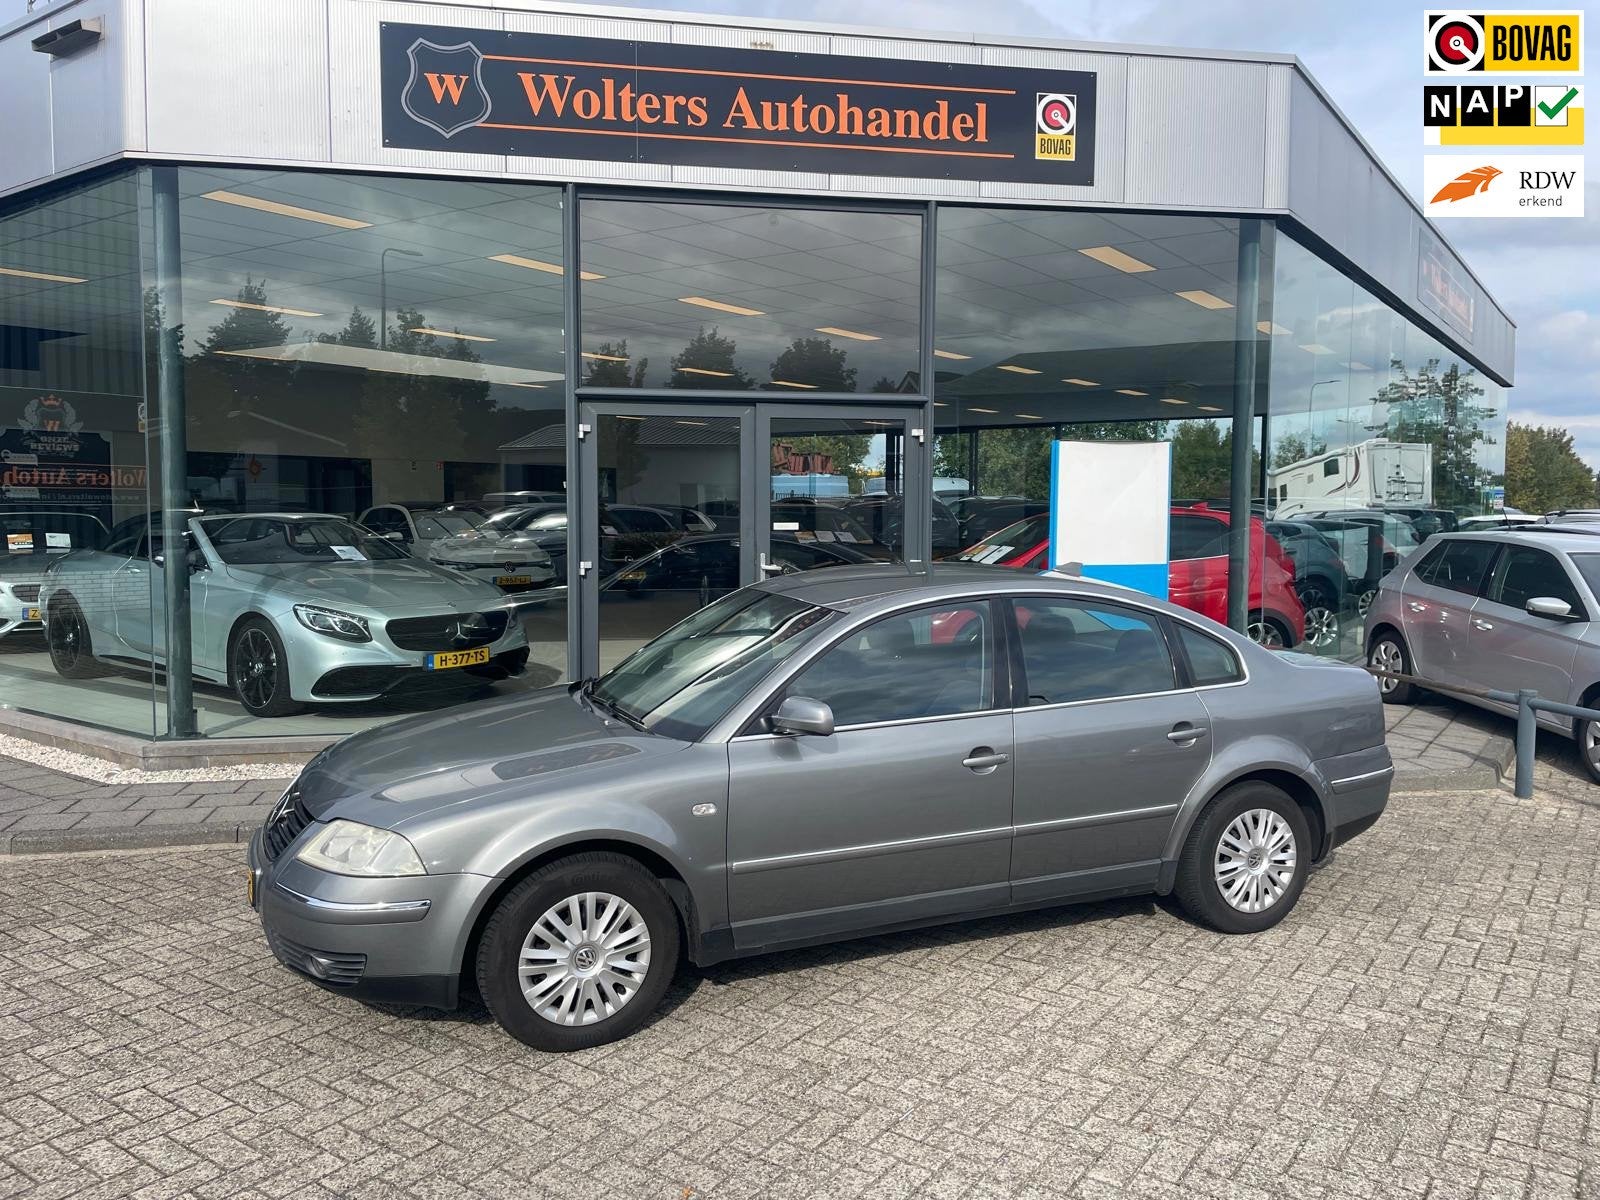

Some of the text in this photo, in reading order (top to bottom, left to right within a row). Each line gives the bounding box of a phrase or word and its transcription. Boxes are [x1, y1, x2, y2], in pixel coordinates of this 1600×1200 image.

[424, 73, 469, 105] W
[517, 72, 988, 142] Wolters Autohandel
[1038, 136, 1072, 158] BOVAG
[440, 651, 485, 667] H-377-TS
